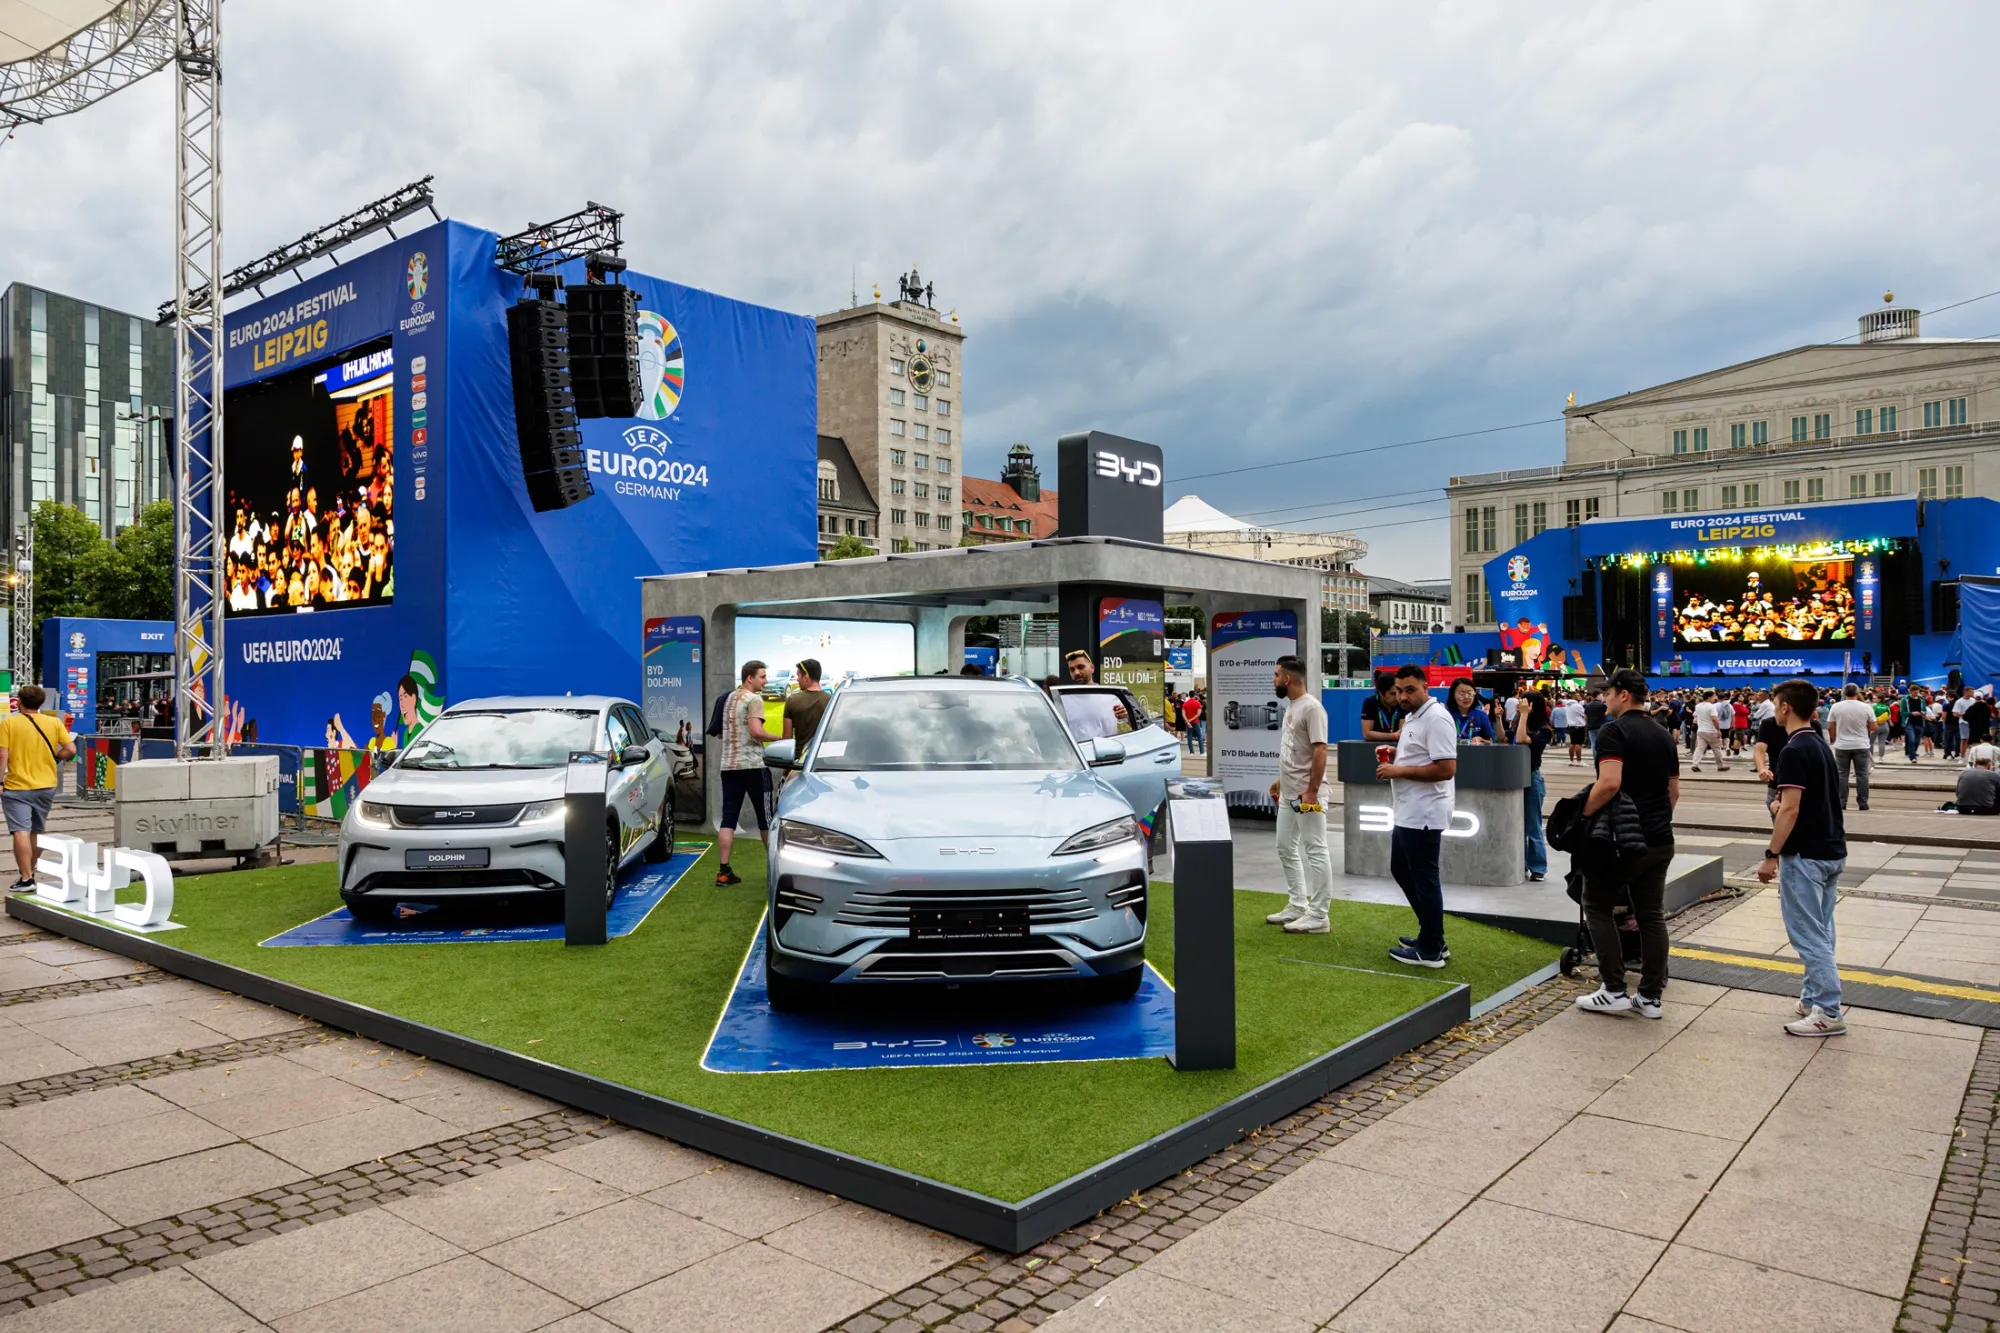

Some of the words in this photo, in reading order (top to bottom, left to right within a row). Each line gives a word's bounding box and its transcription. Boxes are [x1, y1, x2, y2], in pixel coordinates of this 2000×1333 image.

[230, 320, 262, 348] EURO
[263, 306, 294, 336] 2024
[296, 281, 357, 322] FESTIVAL
[400, 310, 435, 331] EURO2024
[253, 319, 328, 371] LEIPZIG
[625, 430, 668, 453] UEFA
[586, 448, 709, 487] EURO2024
[1095, 451, 1161, 486] BYD
[615, 480, 681, 501] GERMANY
[1671, 519, 1705, 530] EURO
[1707, 516, 1741, 527] 2024
[1743, 512, 1805, 524] FESTIVAL
[1698, 524, 1776, 541] LEIPZIG
[1501, 589, 1538, 597] EURO2024
[647, 665, 664, 675] BYD
[1103, 656, 1122, 669] BYD
[1236, 659, 1275, 667] e-Platform
[647, 677, 682, 687] DOLPHIN
[1103, 672, 1127, 684] SEAL
[1128, 672, 1135, 684] U
[1136, 672, 1157, 684] DM-i
[1221, 749, 1237, 757] BYD
[1260, 750, 1280, 758] Batte
[136, 814, 239, 836] skyliner
[1359, 805, 1480, 838] BD
[428, 854, 466, 862] DOLPHIN
[940, 847, 997, 856] BYD
[37, 833, 174, 926] BYD
[833, 1039, 947, 1050] BYD
[1023, 1035, 1096, 1043] EURO2024
